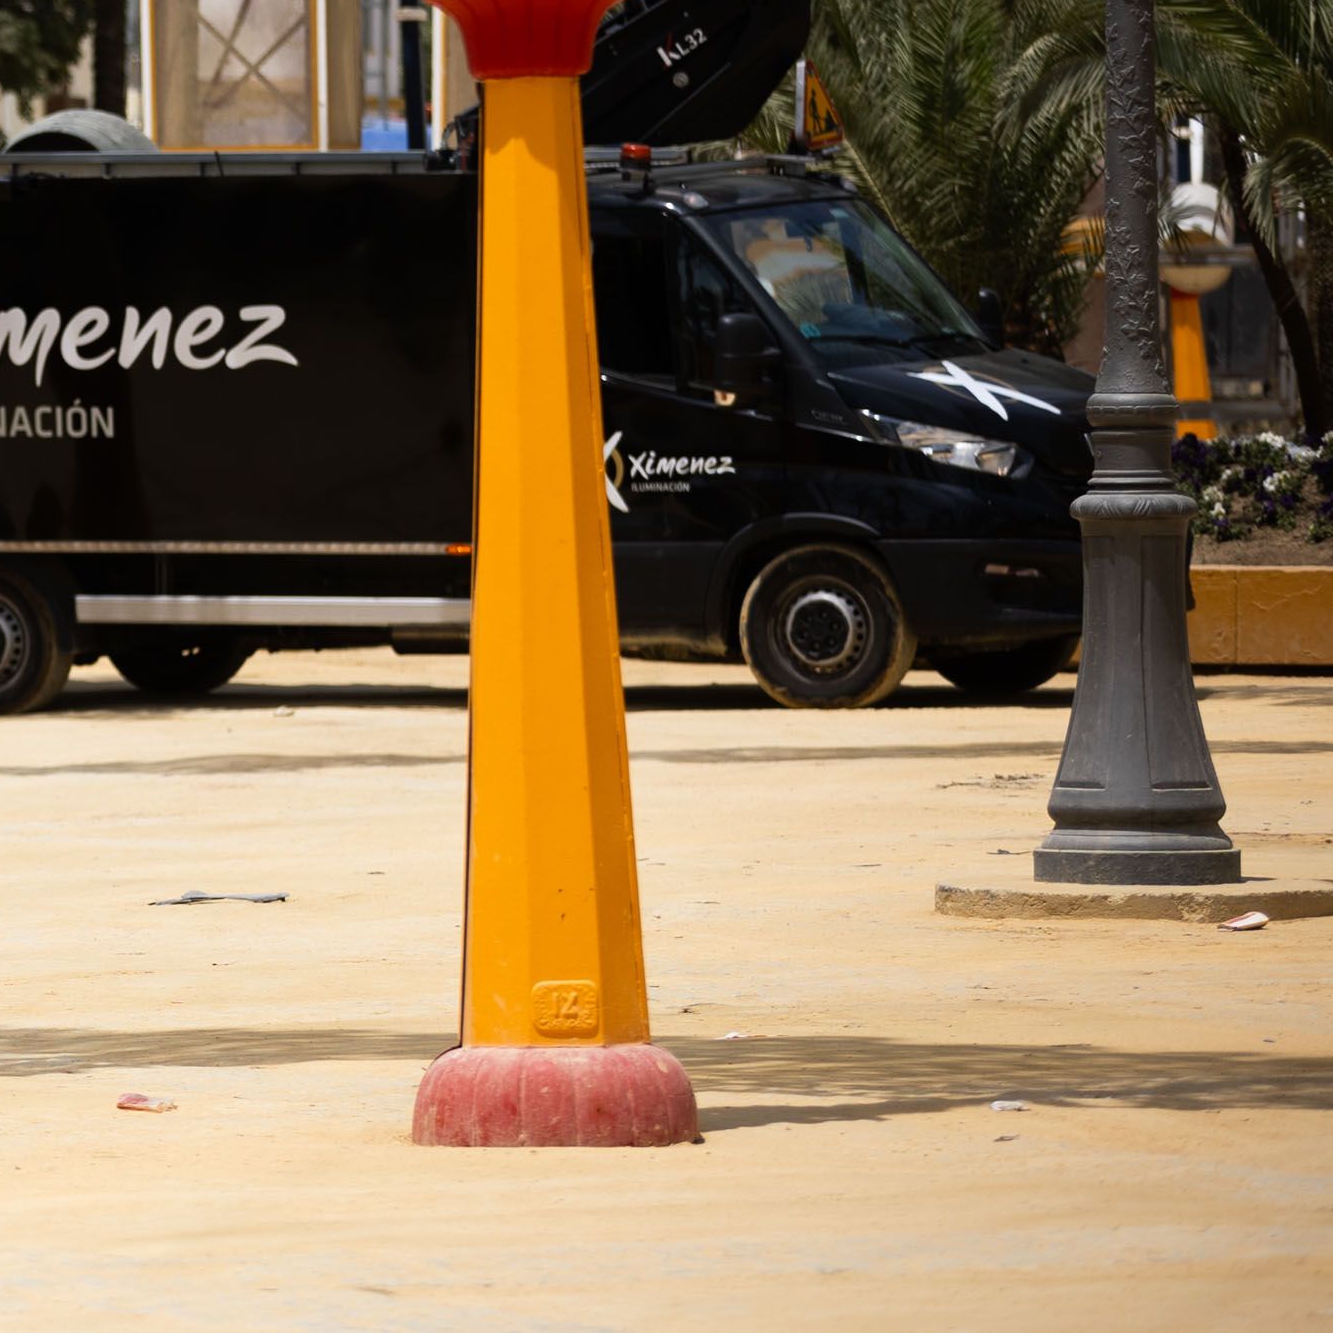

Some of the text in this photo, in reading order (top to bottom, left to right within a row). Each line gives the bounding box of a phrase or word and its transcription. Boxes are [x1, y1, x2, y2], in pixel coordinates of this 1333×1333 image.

[656, 28, 708, 68] KL32
[627, 450, 737, 480] Ximenez
[630, 481, 691, 492] ILUMINACIÓN
